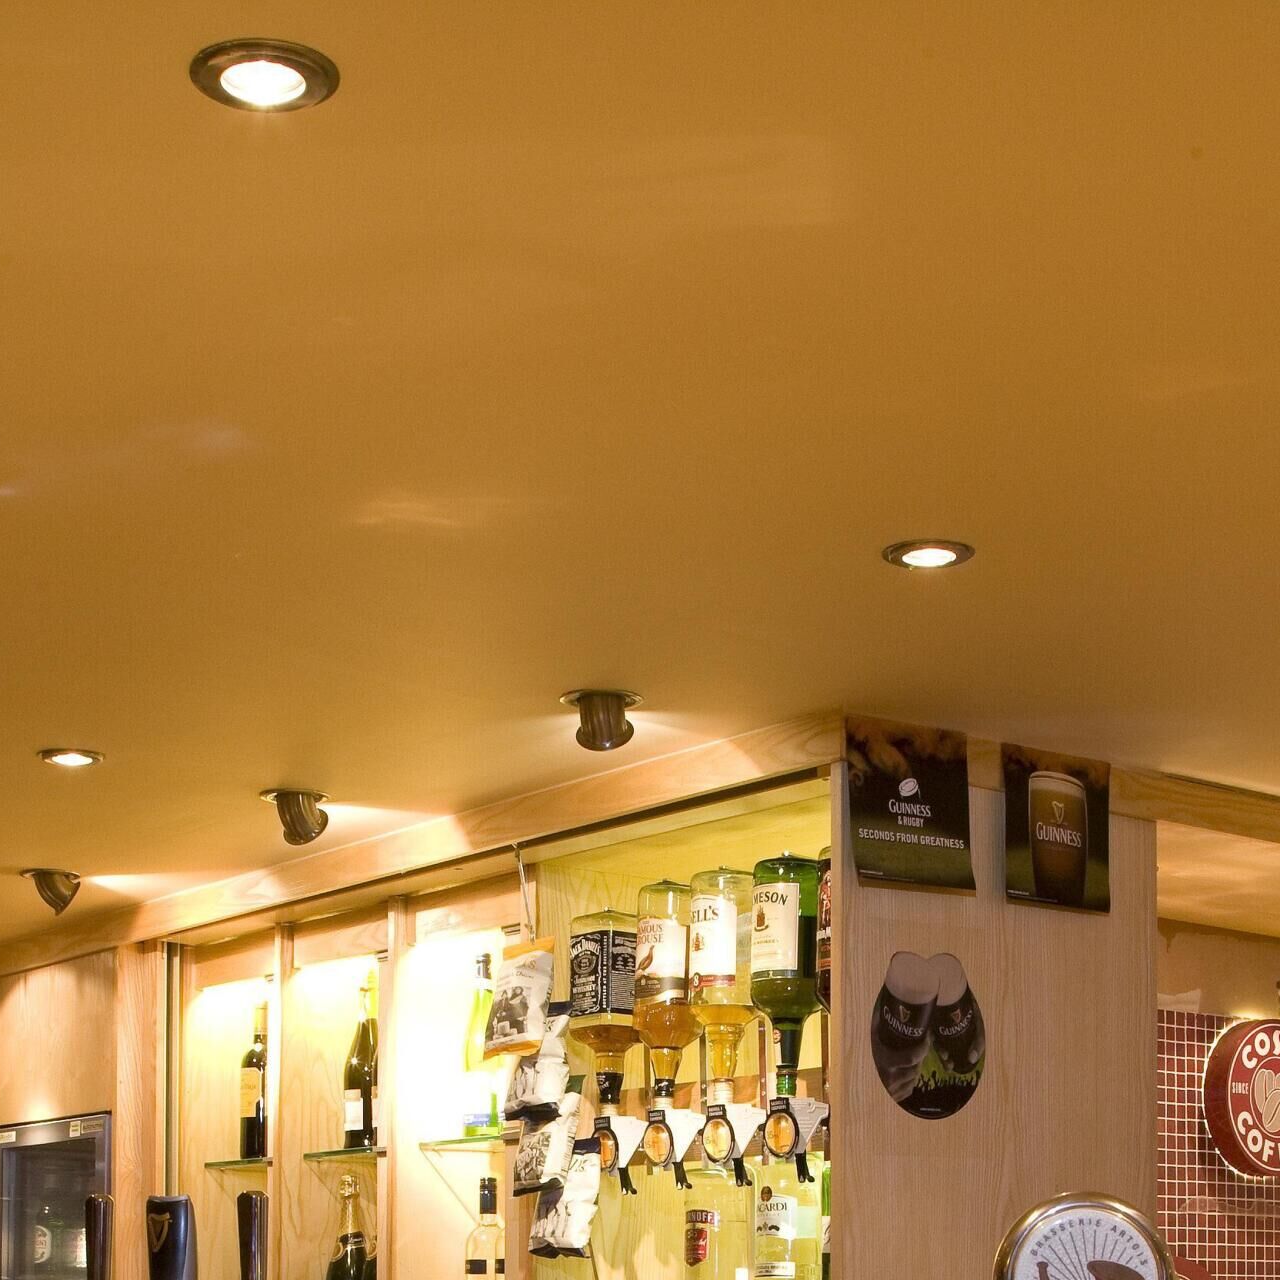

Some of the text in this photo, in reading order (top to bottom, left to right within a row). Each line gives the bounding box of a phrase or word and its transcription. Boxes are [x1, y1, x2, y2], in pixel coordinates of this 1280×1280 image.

[888, 799, 932, 817] GUINNESS
[897, 816, 924, 828] & RUGBY
[858, 828, 965, 849] SECONDS FROM GREATNESS
[1035, 821, 1082, 848] GUINNESS
[883, 1005, 924, 1037] GUINNESS
[1232, 1081, 1249, 1095] SINCE
[1031, 1218, 1149, 1266] BRASSERIE ARTOIS
